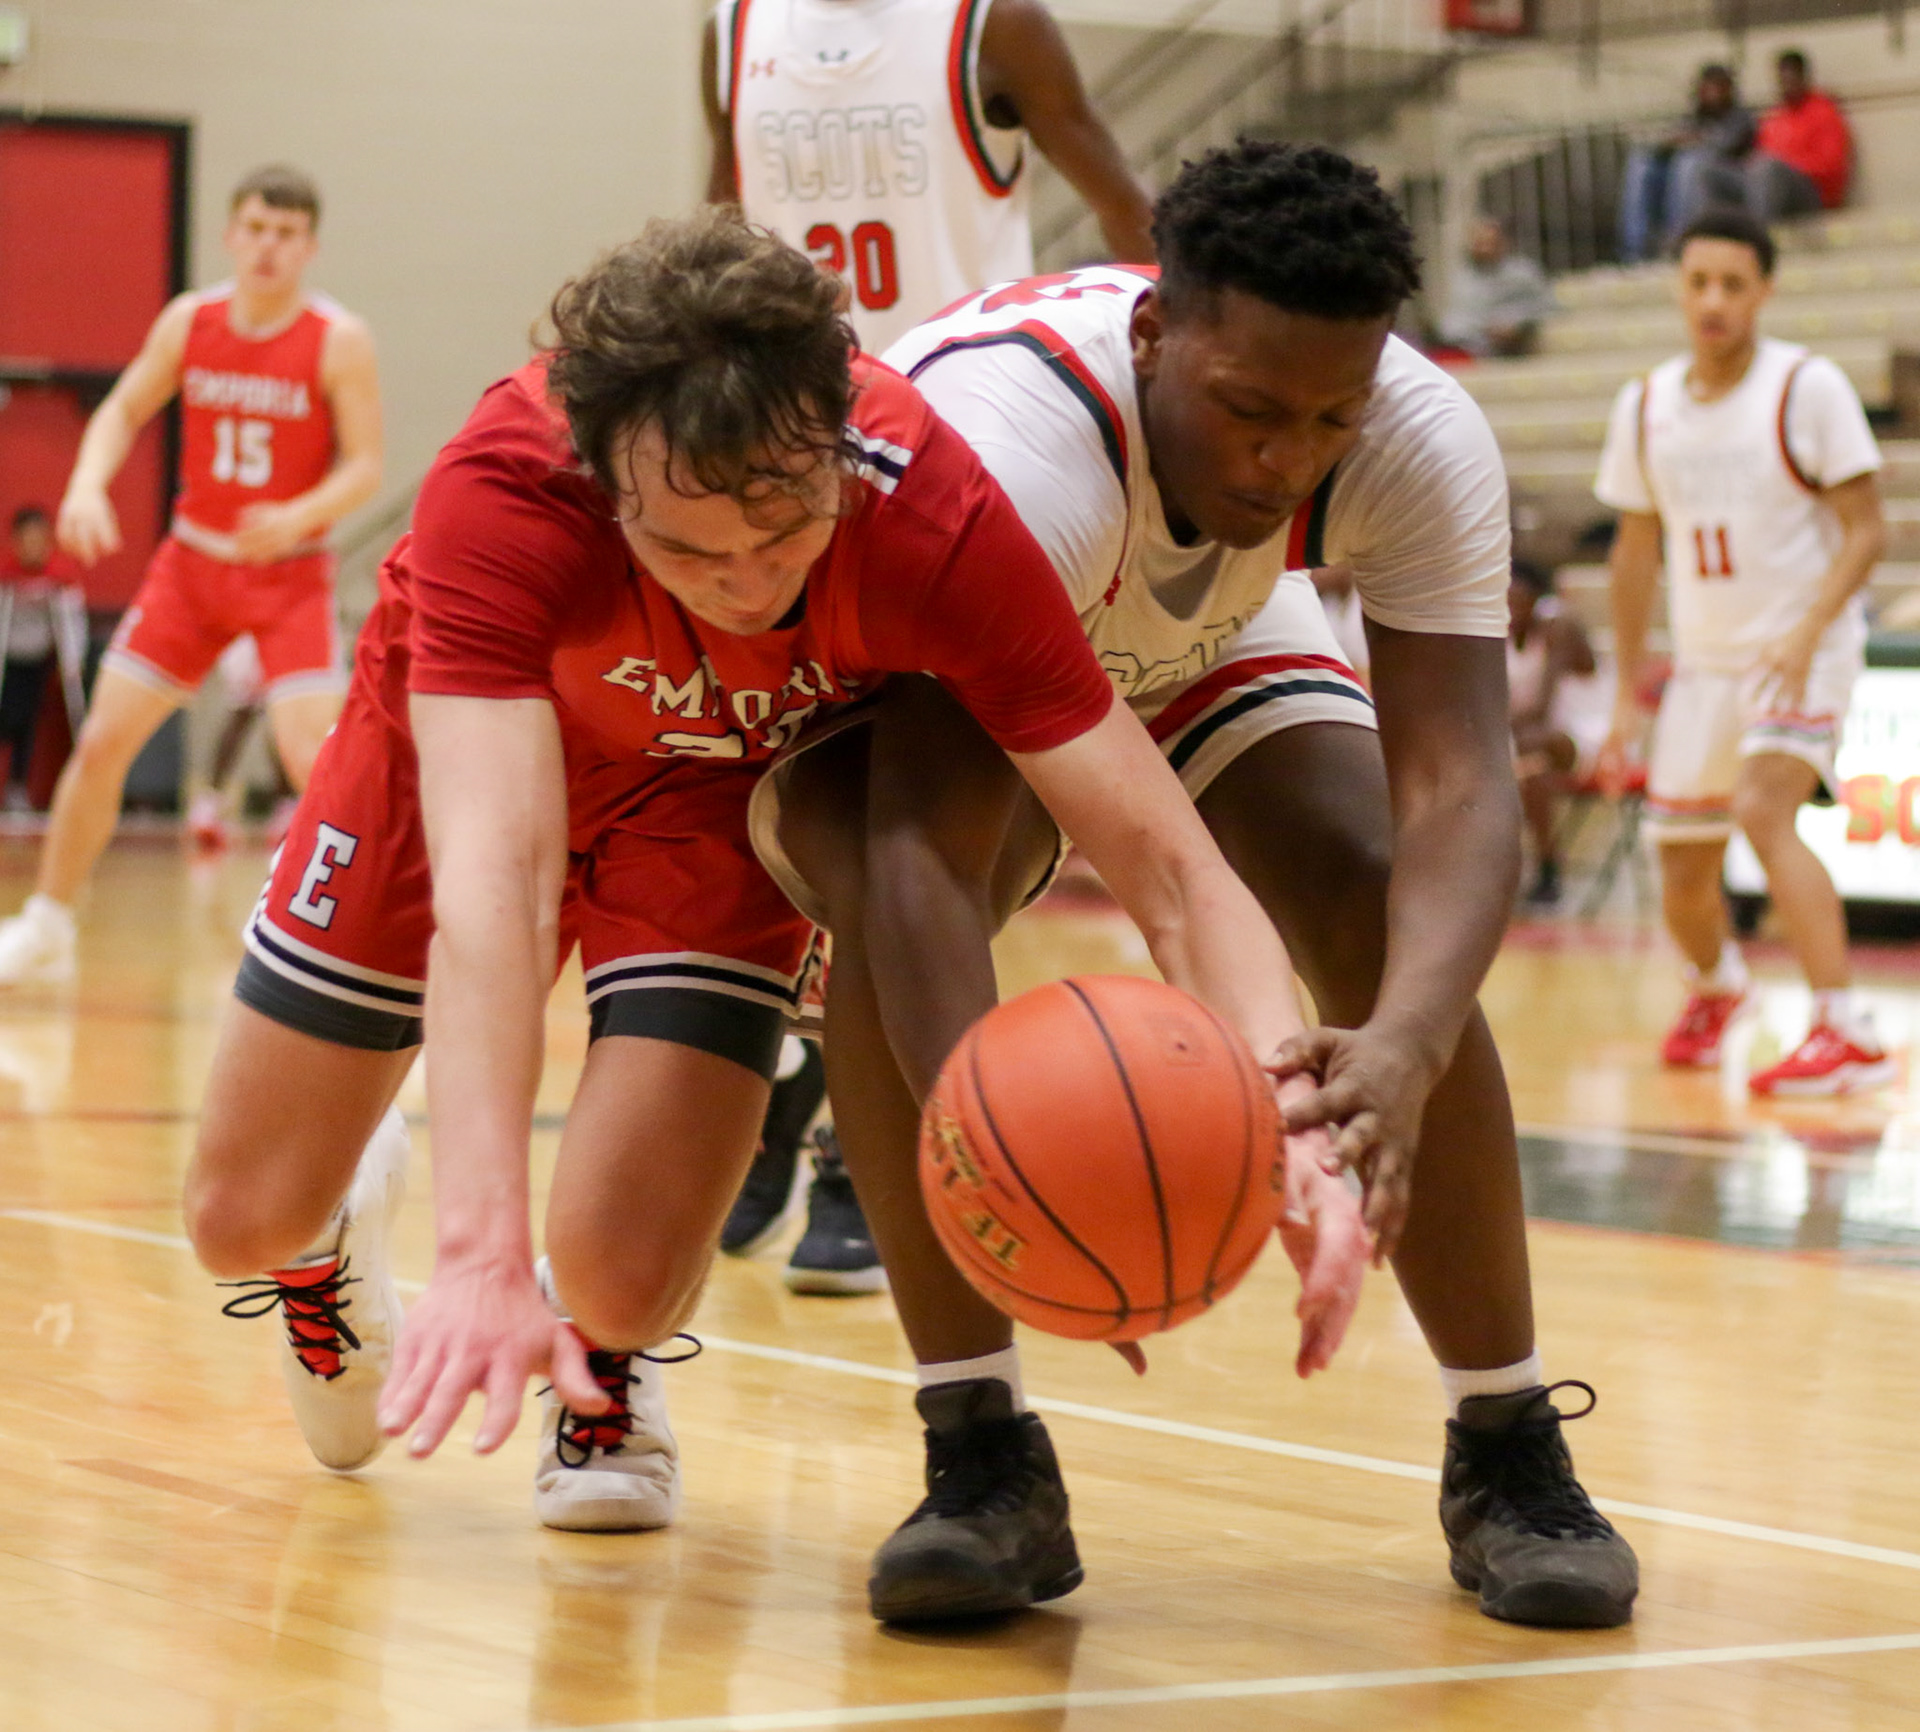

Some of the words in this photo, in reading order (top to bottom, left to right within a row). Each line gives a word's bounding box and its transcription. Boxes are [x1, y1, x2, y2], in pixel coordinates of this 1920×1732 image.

[756, 104, 928, 203] SCOTS
[185, 368, 309, 421] EMPORIA
[212, 418, 273, 488] 15
[1694, 524, 1735, 578] 11
[287, 820, 361, 932] E
